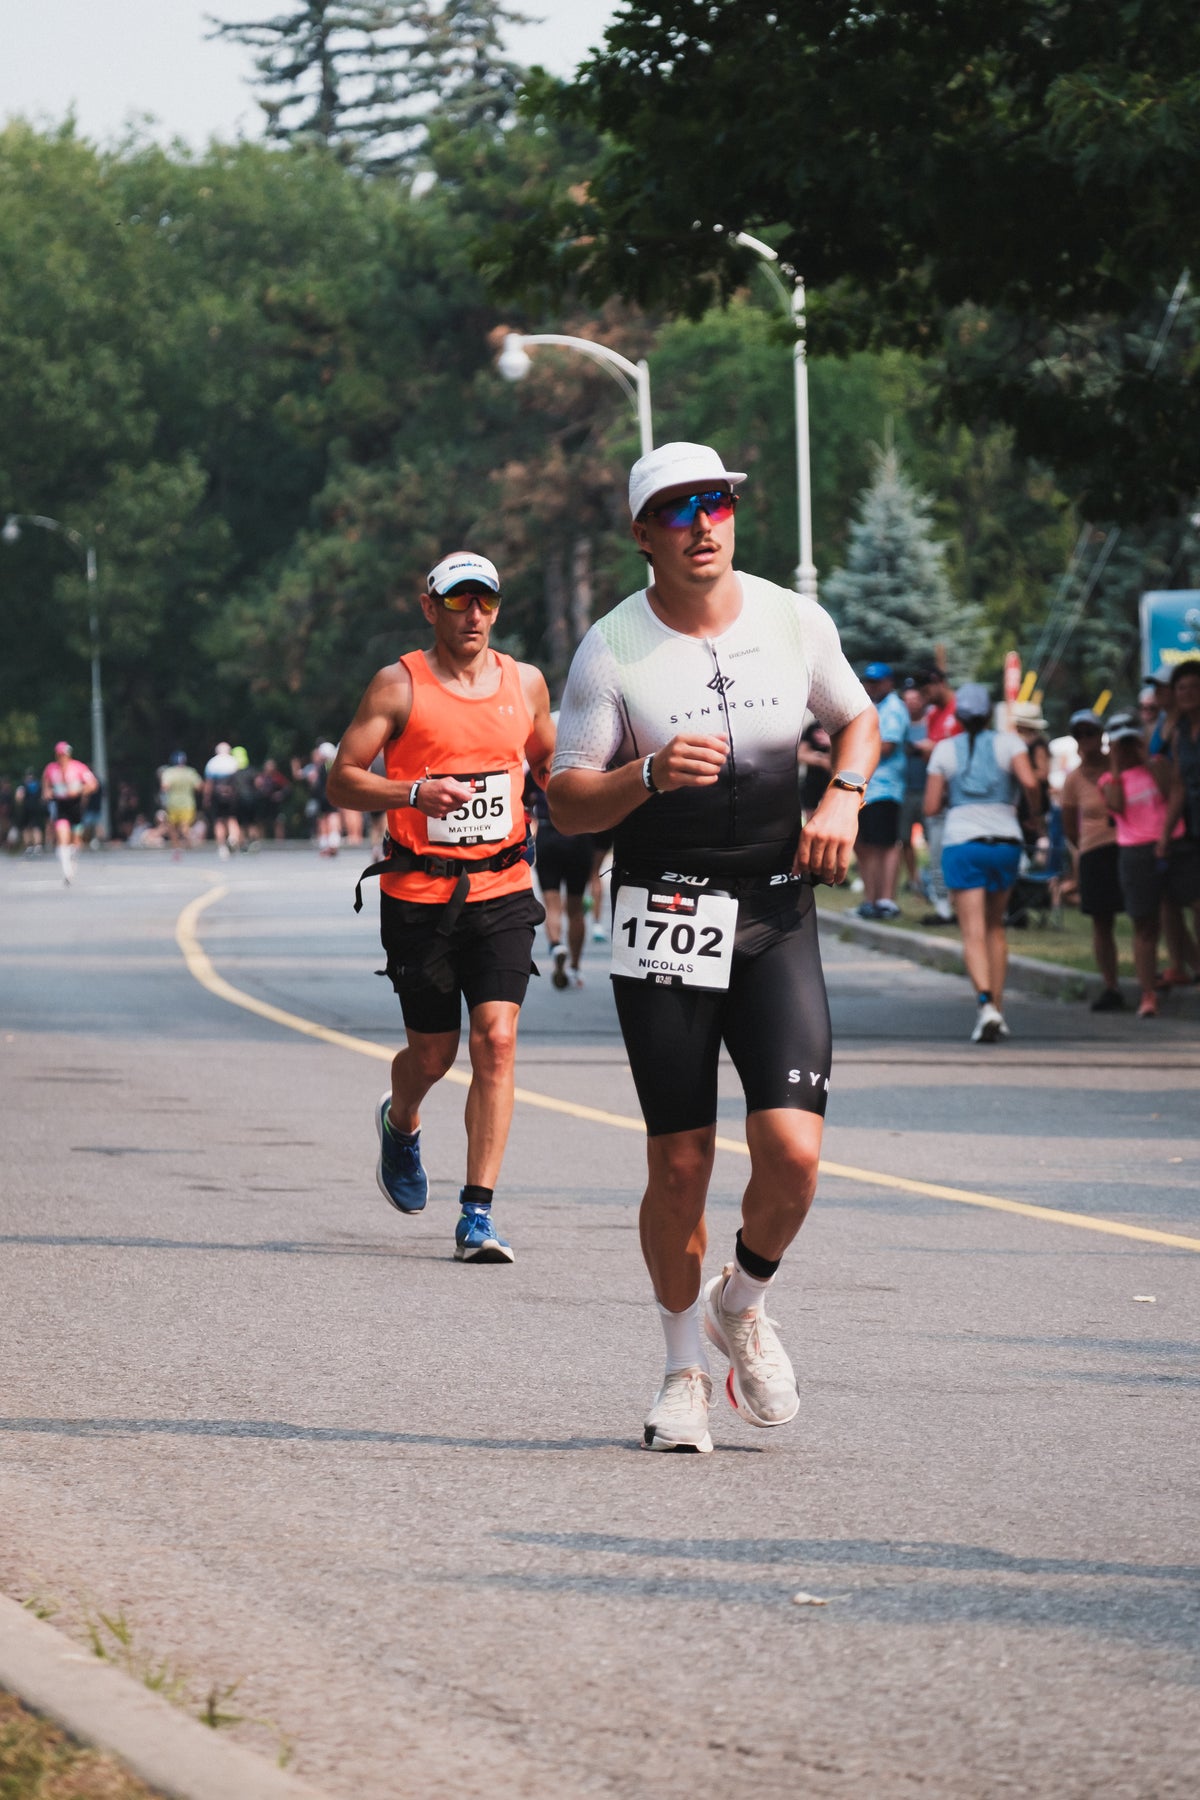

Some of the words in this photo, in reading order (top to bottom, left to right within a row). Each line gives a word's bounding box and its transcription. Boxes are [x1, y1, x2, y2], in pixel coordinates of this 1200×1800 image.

[670, 697, 779, 724] SYNERGIE
[440, 796, 504, 821] 505
[448, 824, 492, 834] MATTHEW
[661, 871, 710, 887] 2XU
[621, 917, 724, 958] 1702
[638, 957, 694, 973] NICOLAS
